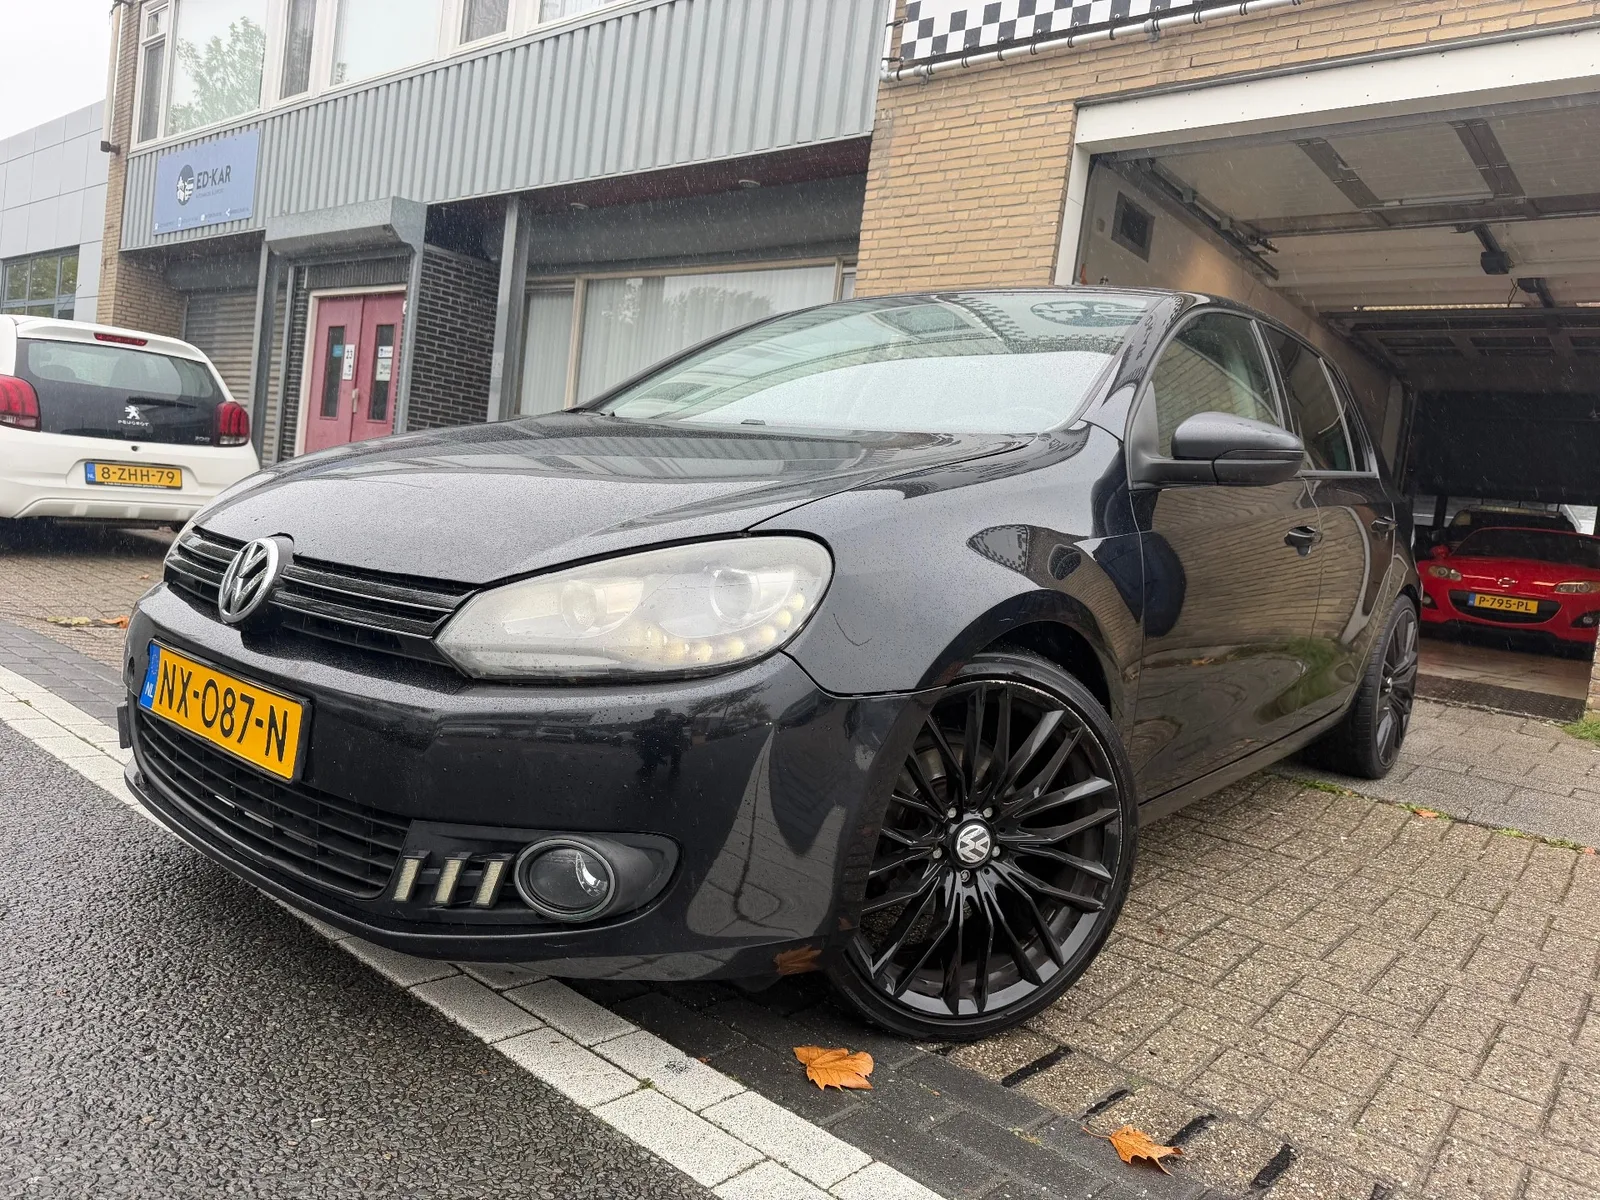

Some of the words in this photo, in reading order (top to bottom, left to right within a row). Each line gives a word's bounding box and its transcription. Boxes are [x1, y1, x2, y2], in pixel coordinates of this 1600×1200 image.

[101, 466, 175, 484] 8-ZHH-79
[1478, 596, 1531, 611] P-795-PL
[145, 682, 153, 698] NL
[159, 660, 288, 763] NX-087-N
